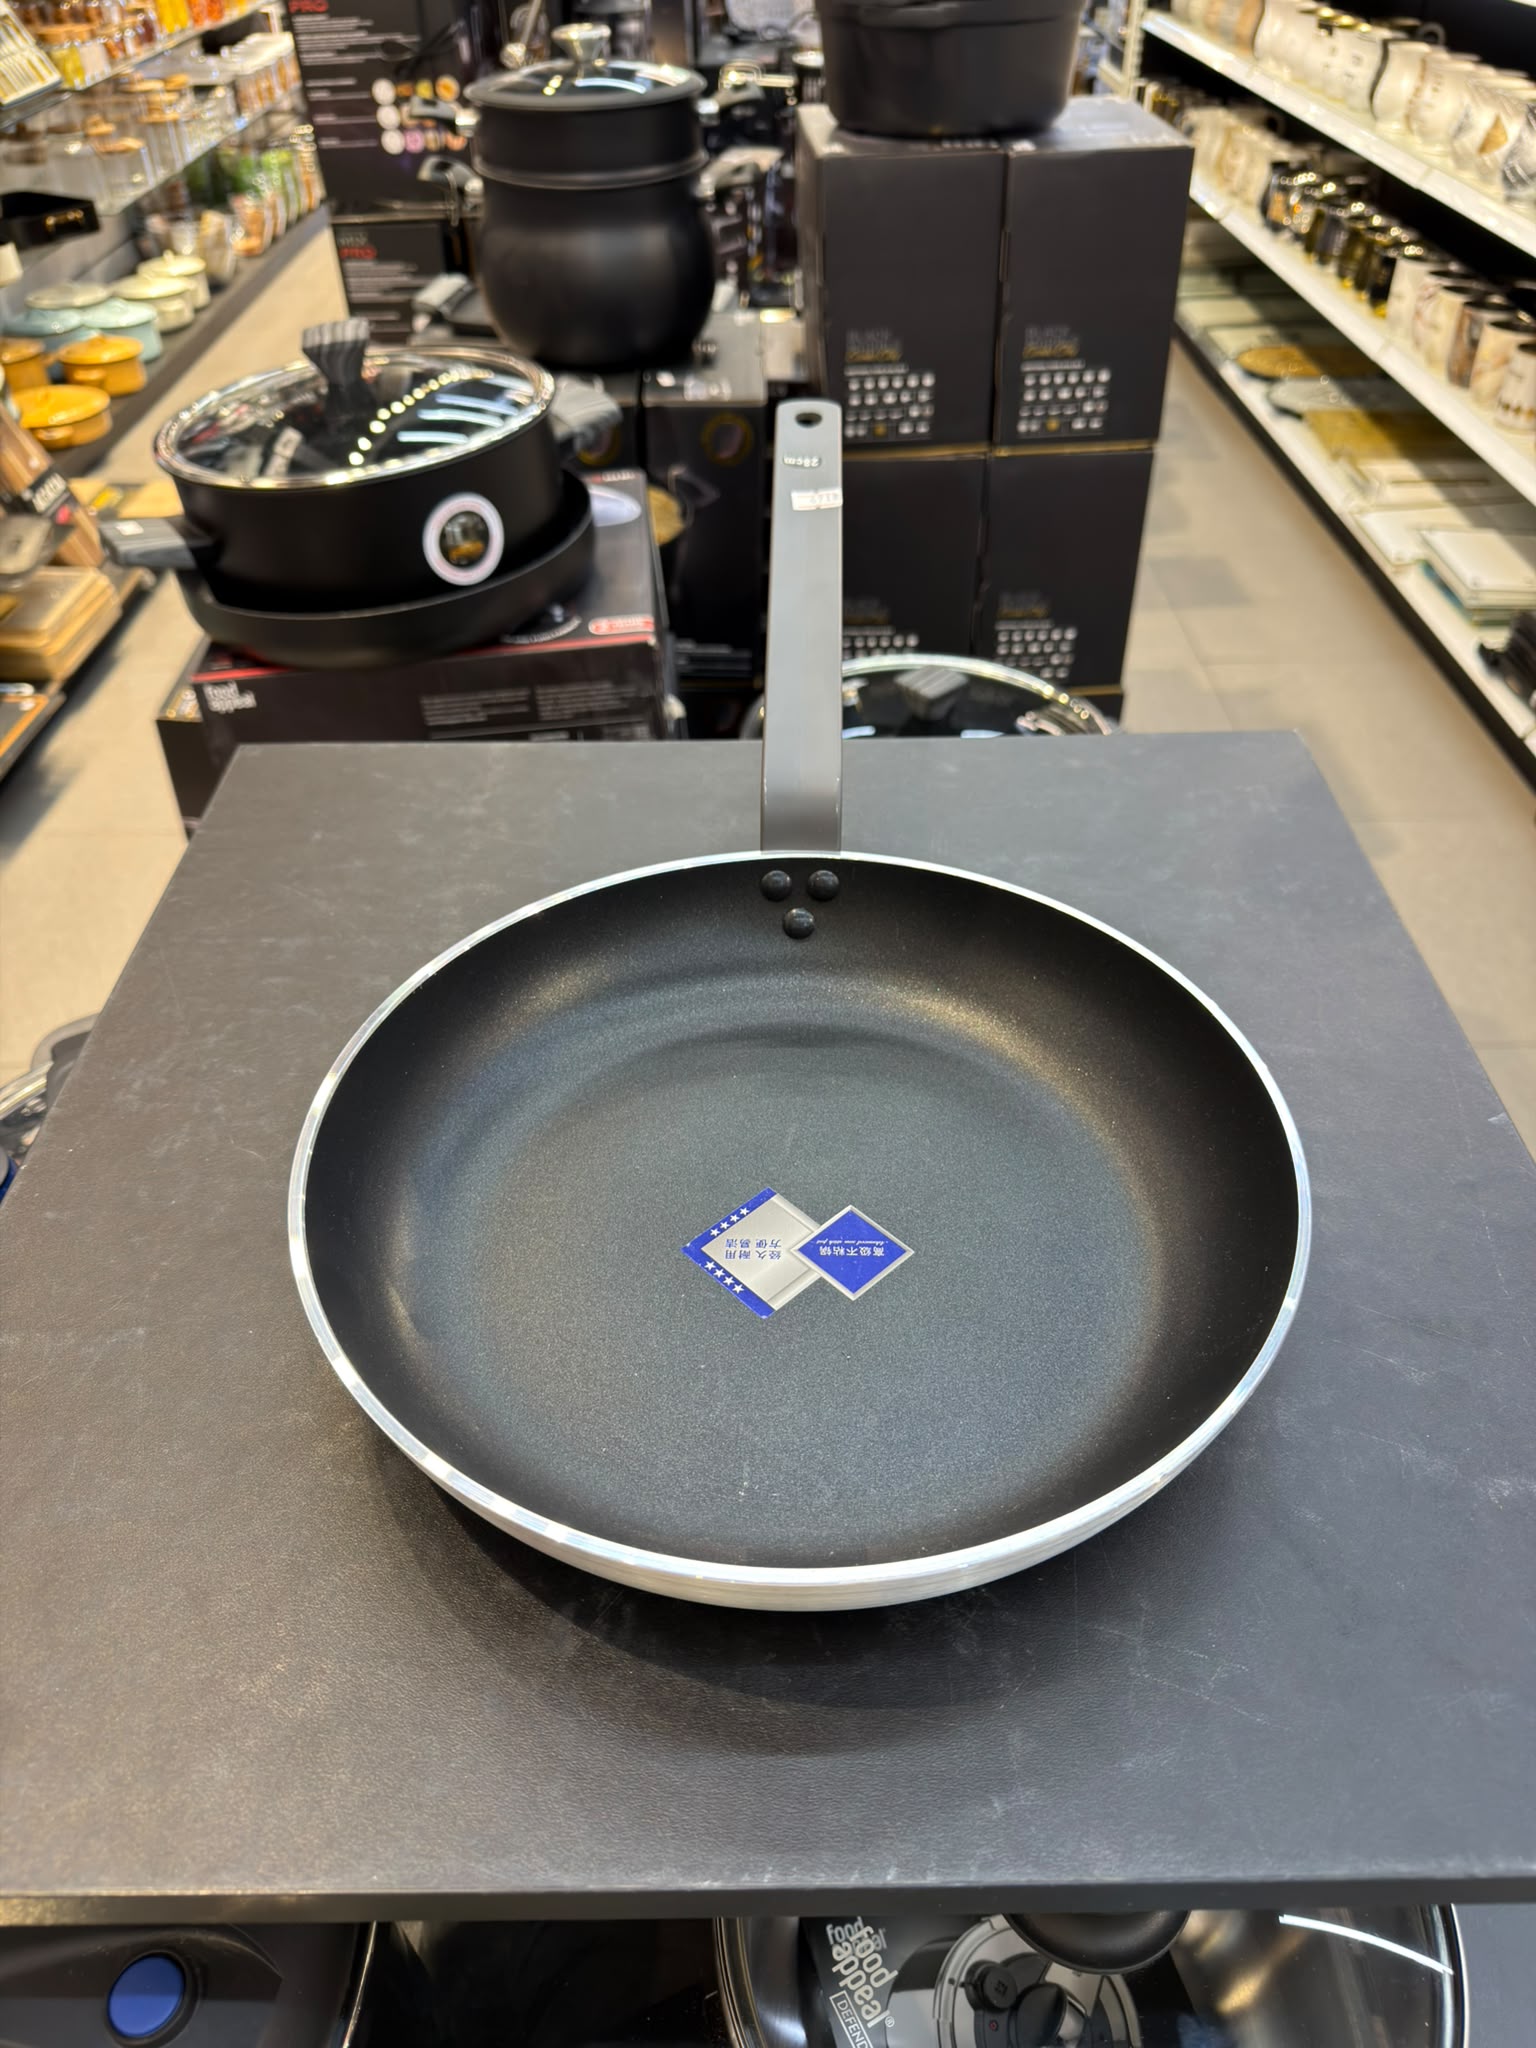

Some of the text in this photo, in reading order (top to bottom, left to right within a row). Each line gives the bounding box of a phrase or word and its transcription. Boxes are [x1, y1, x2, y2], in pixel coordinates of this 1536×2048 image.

[783, 456, 819, 468] 28cm
[819, 1246, 885, 1257] 高级不粘锅
[849, 1925, 899, 1988] food
